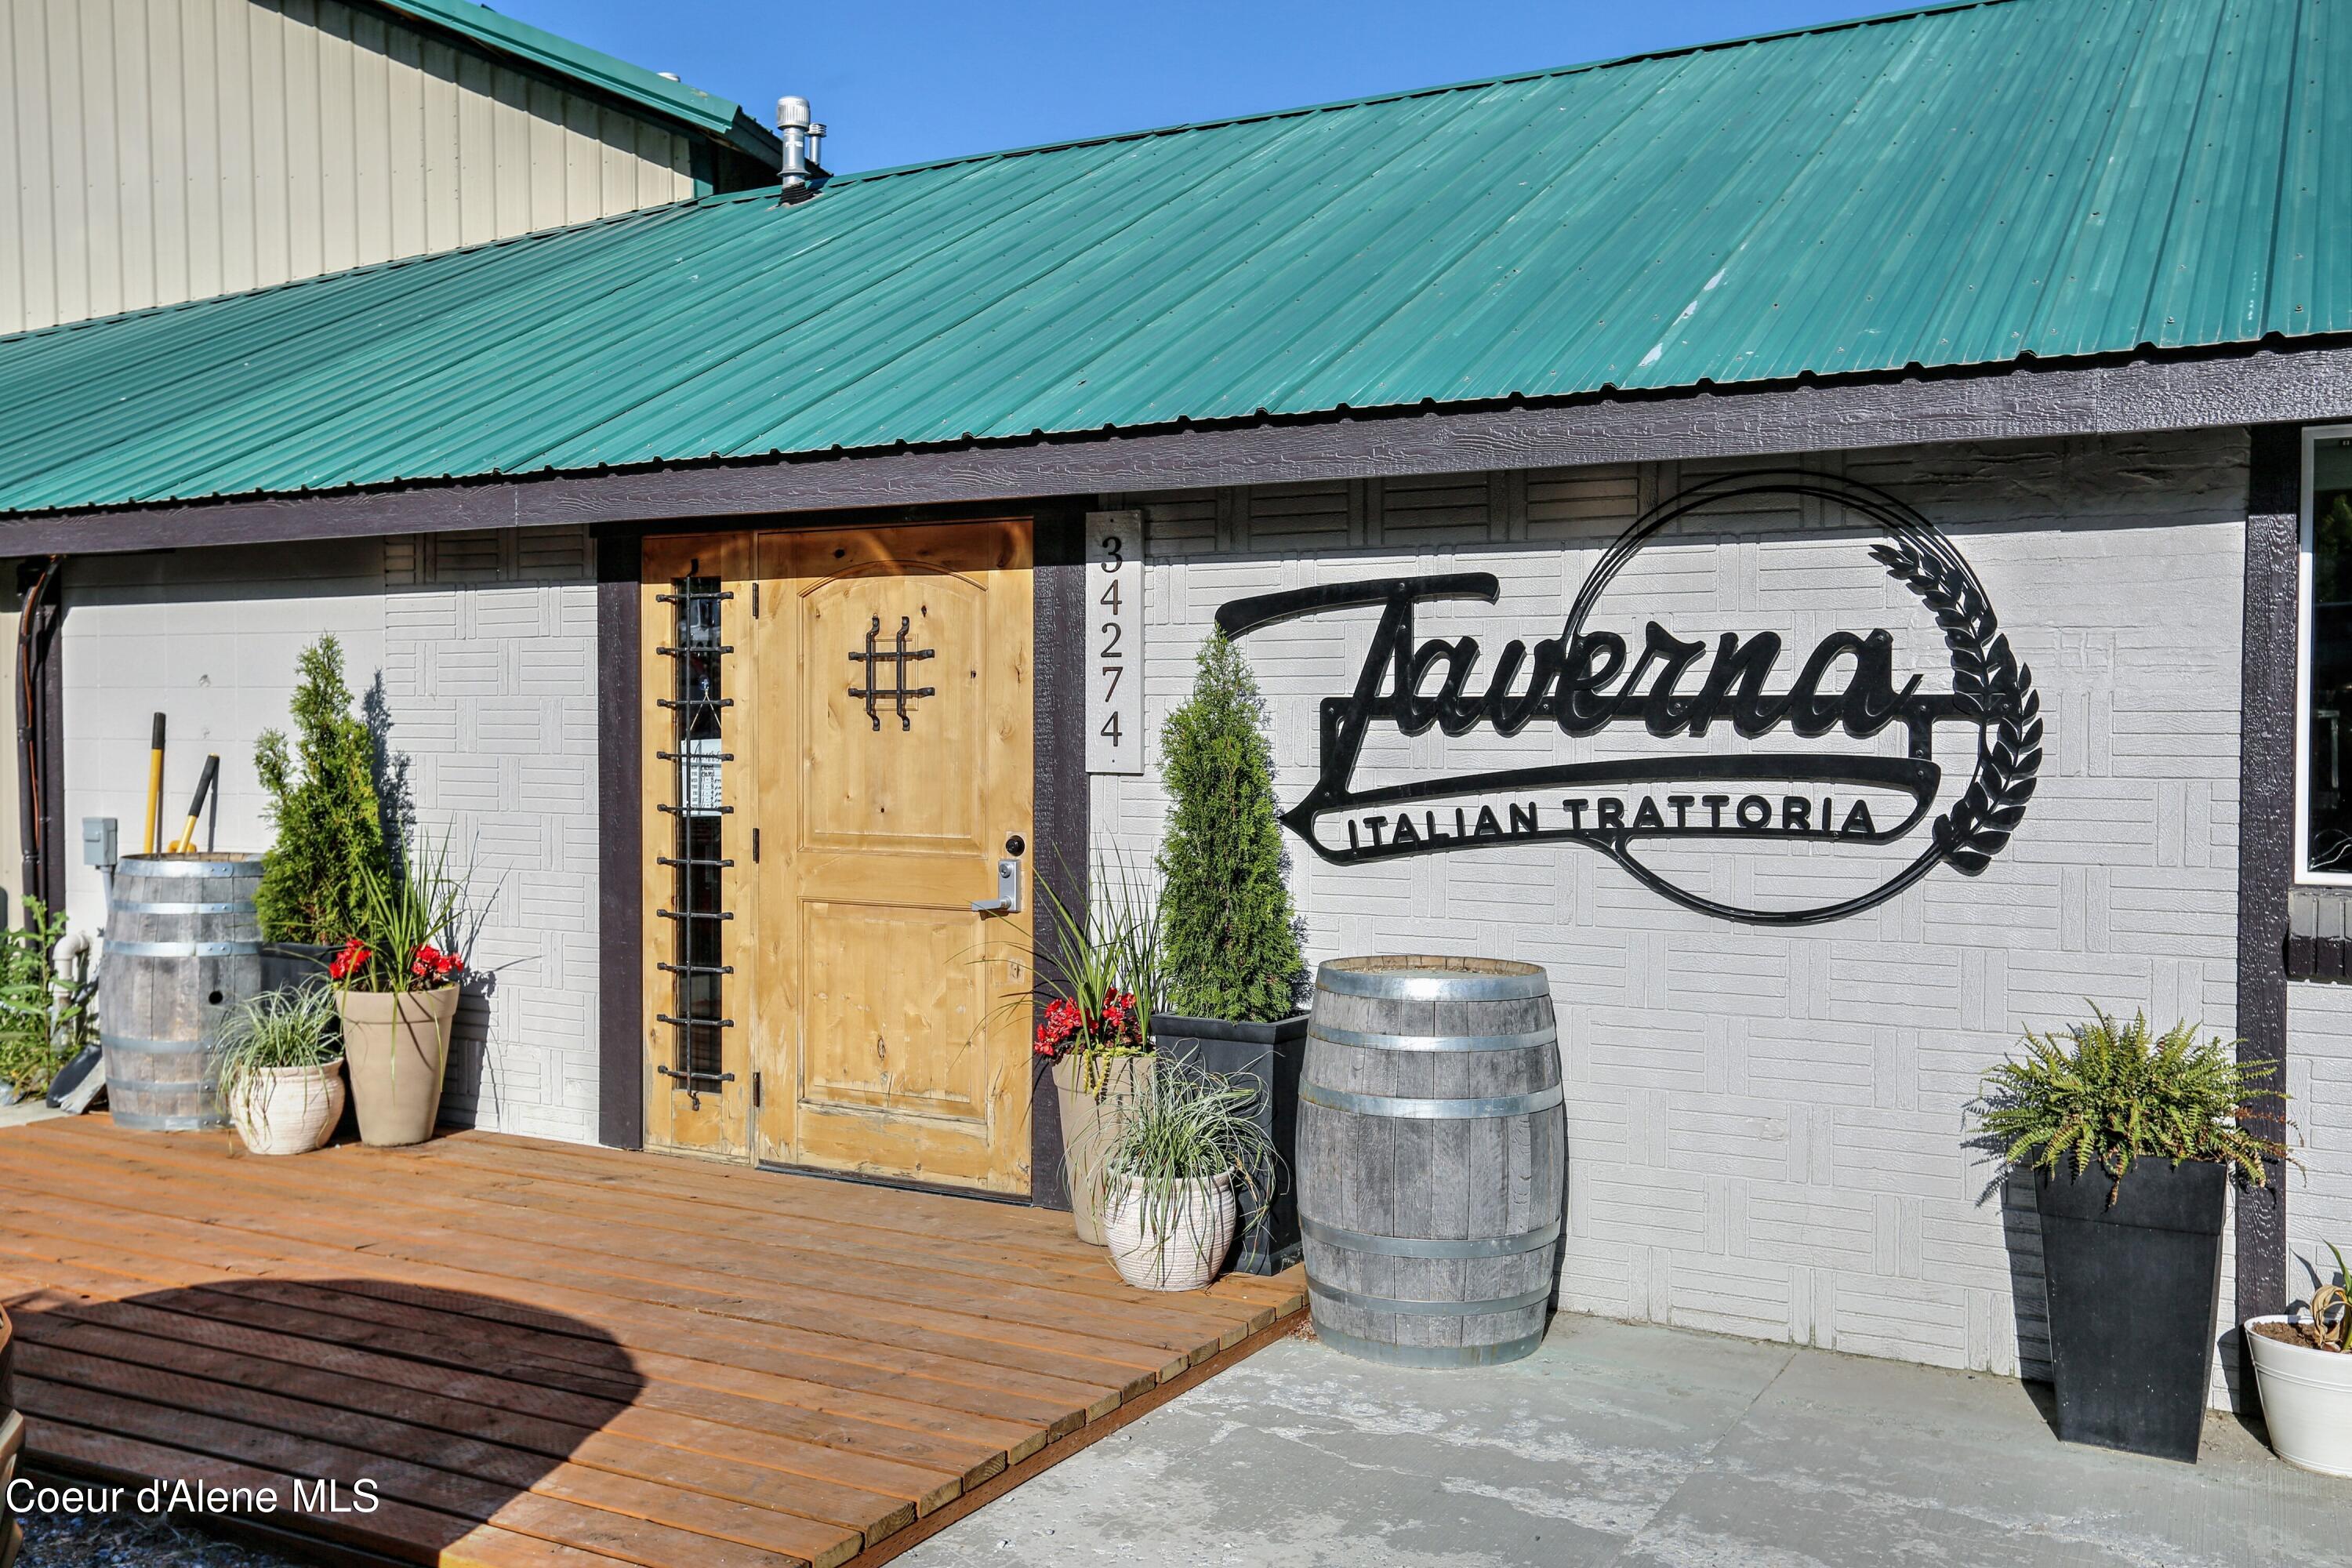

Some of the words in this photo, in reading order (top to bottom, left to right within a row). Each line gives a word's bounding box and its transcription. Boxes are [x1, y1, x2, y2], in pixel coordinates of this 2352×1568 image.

[1100, 536, 1123, 746] 34274
[1214, 572, 1923, 789] Taverna
[1348, 801, 1539, 851] ITALIAN
[1563, 794, 1876, 834] TRATTORIA
